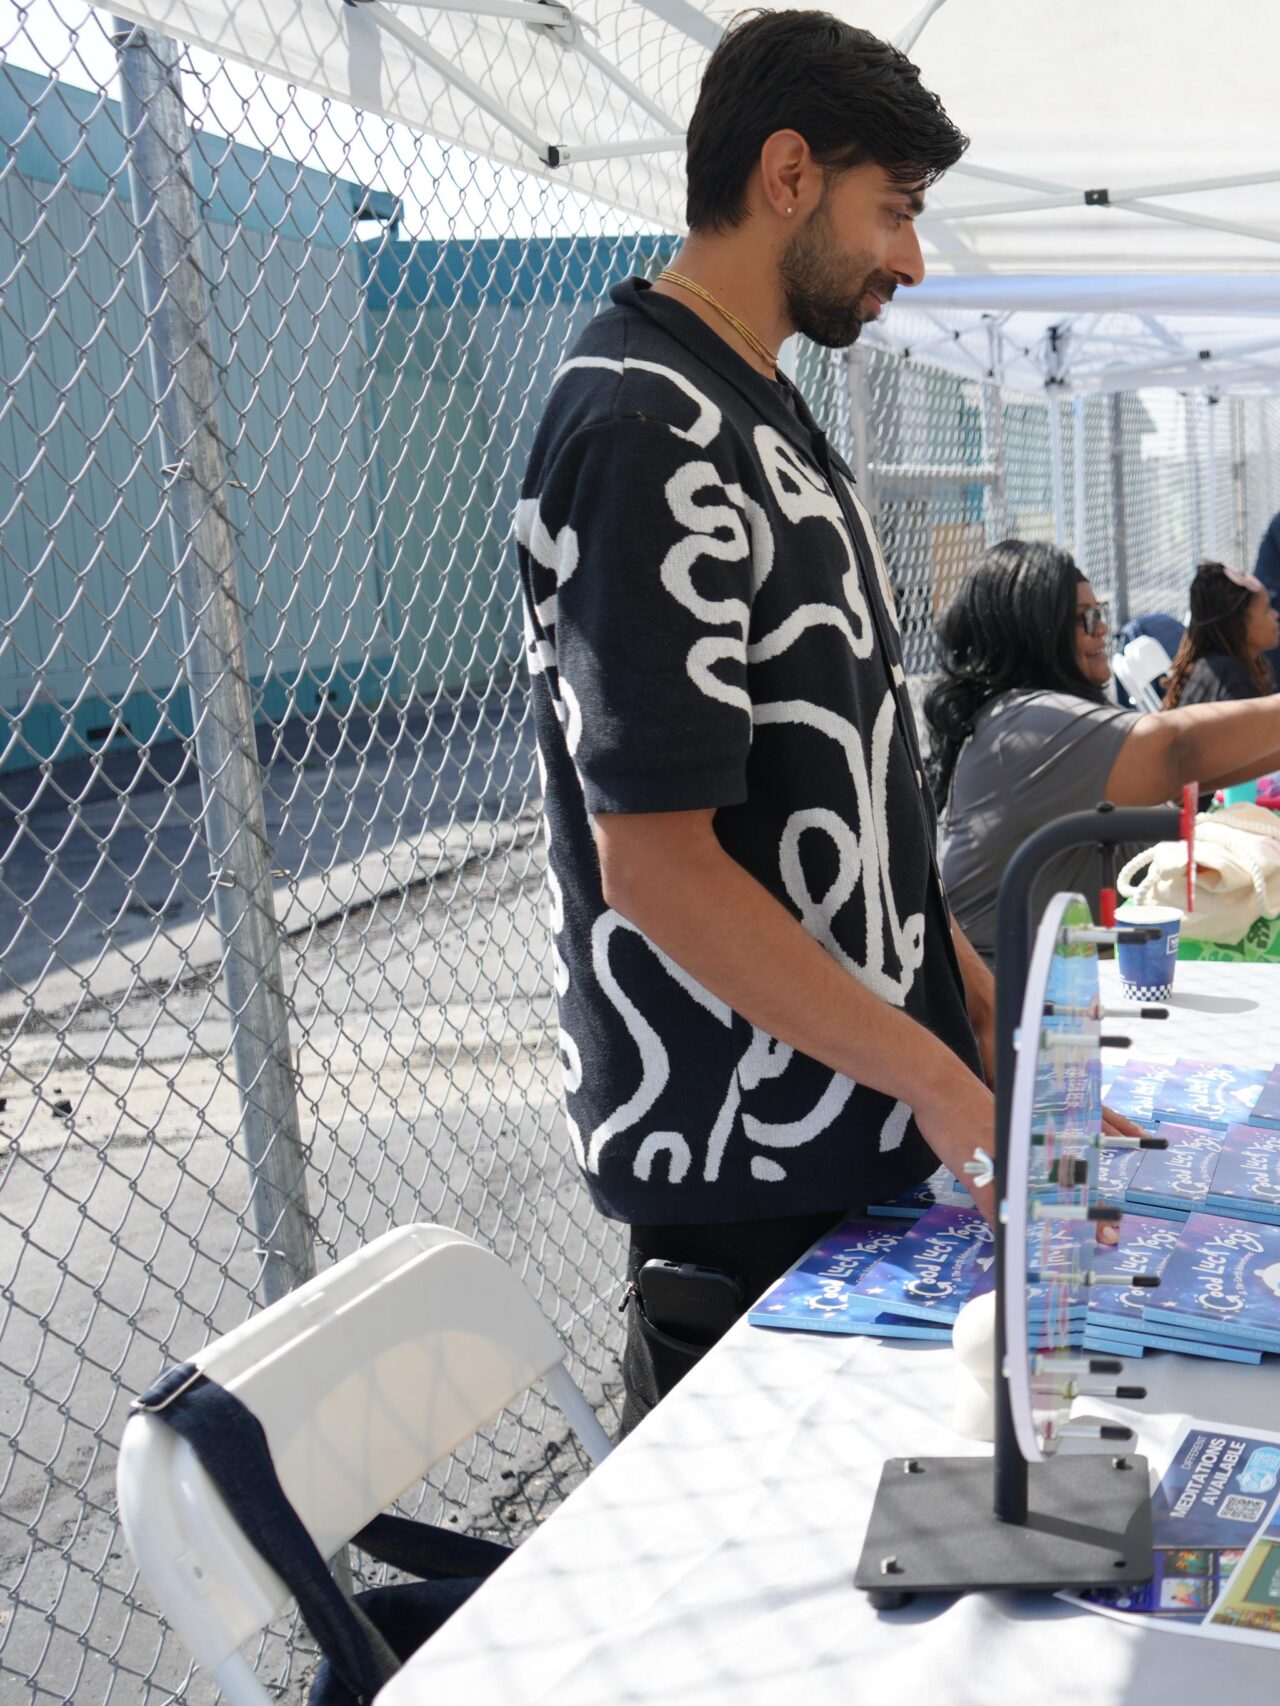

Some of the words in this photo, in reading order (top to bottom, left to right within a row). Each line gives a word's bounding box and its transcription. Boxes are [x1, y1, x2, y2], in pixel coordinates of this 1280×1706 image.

[1175, 1136, 1222, 1153] Yogi
[1164, 1148, 1196, 1168] Luck
[1240, 1151, 1270, 1170] Luck
[1170, 1168, 1209, 1194] Good
[936, 1219, 995, 1243] Yogi
[1205, 1229, 1264, 1253] Yogi
[913, 1237, 958, 1262] Luck
[1114, 1249, 1152, 1274] Luck
[1192, 1248, 1230, 1275] Luck
[818, 1254, 865, 1278] Luck
[905, 1264, 955, 1298] Good
[1197, 1276, 1244, 1311] Good
[1181, 1435, 1207, 1471] DIFFERENT
[1169, 1437, 1227, 1518] MEDITATIONS
[1201, 1440, 1247, 1507] AVAILABLE
